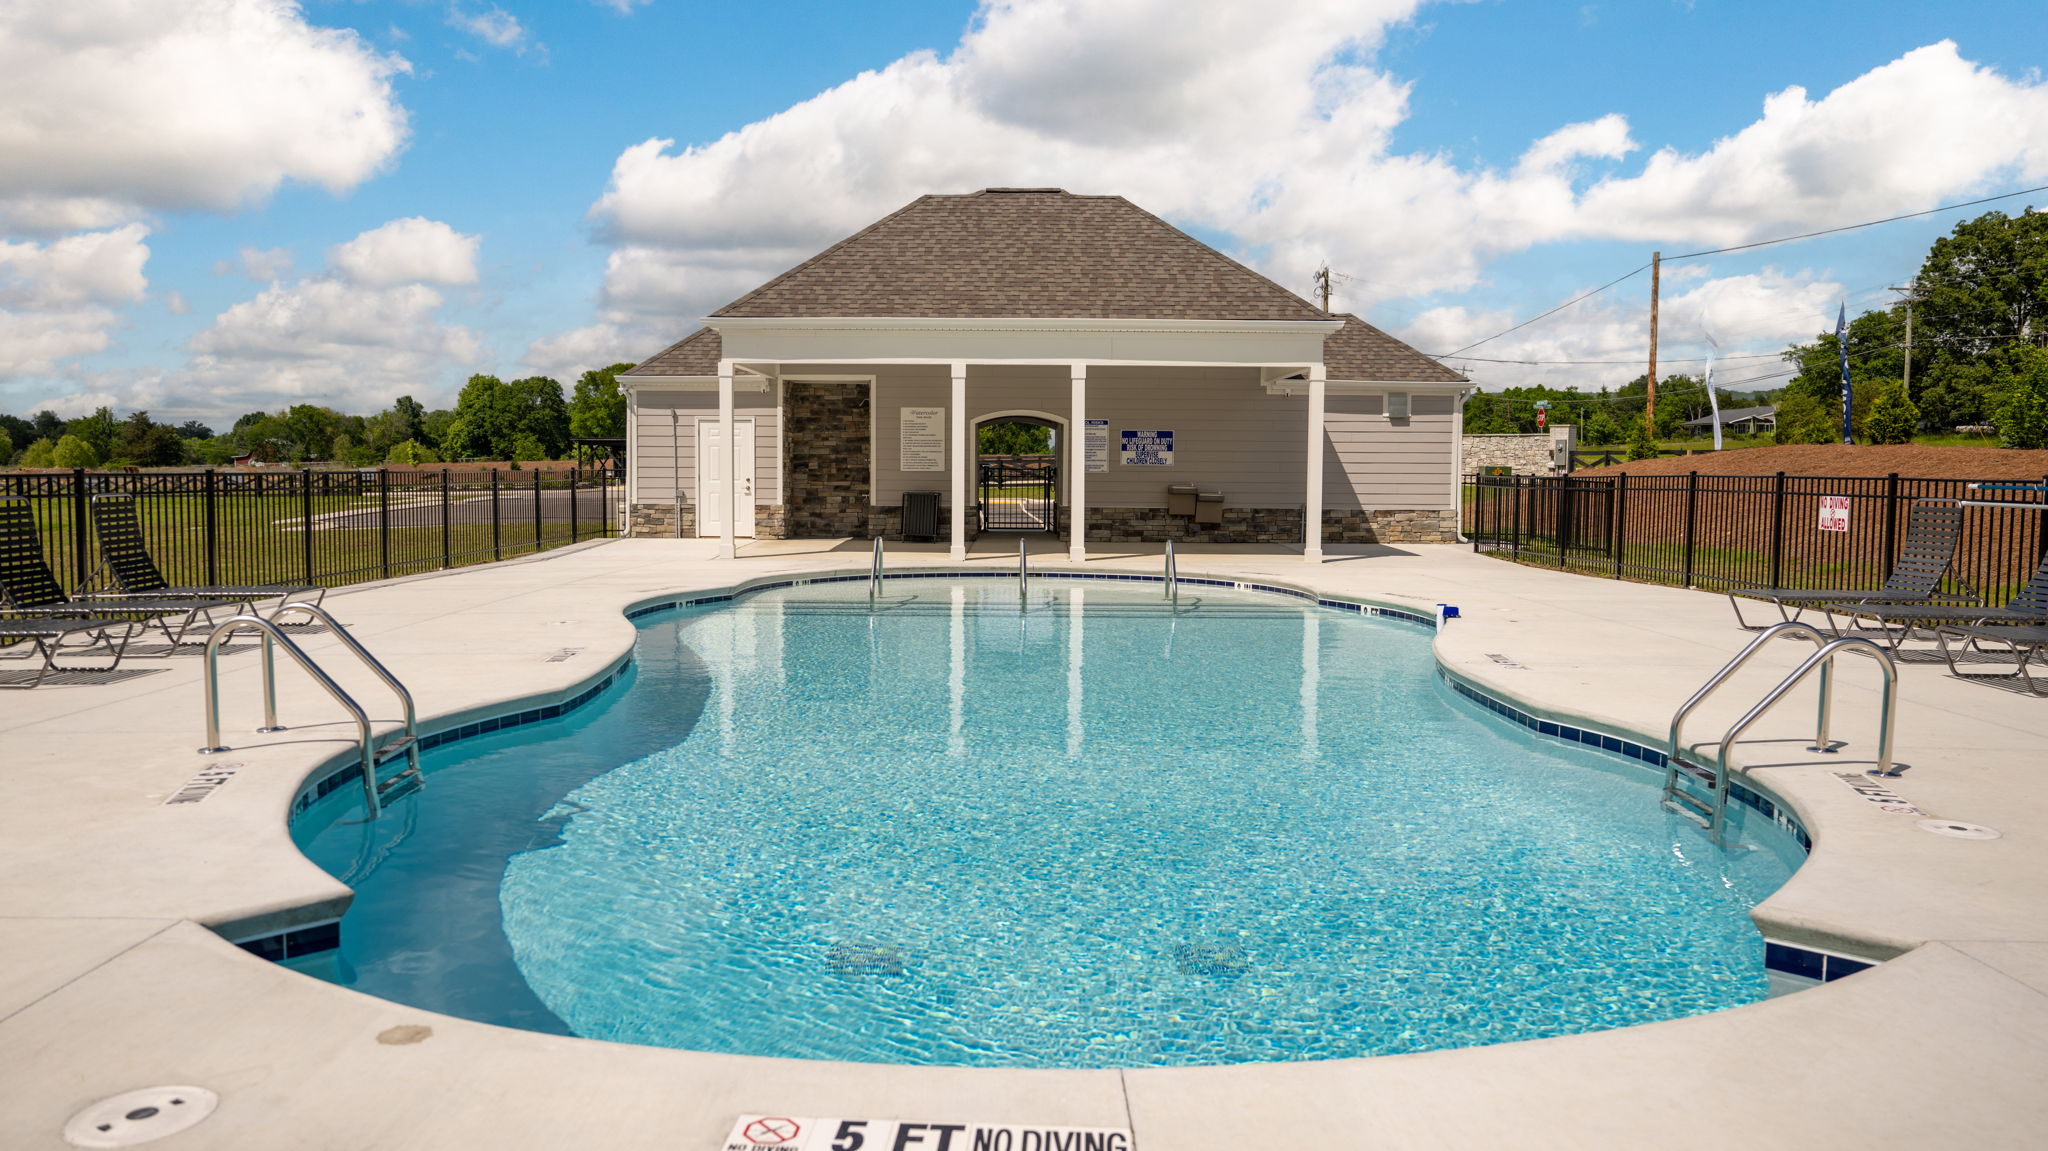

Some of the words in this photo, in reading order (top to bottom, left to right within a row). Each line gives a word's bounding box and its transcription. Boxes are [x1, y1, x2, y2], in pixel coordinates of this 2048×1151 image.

[1820, 496, 1827, 508] NO
[1829, 496, 1848, 509] DIVING
[1821, 517, 1845, 530] ALLOWED
[831, 1121, 867, 1151] 5
[892, 1124, 966, 1151] FT
[973, 1128, 1012, 1151] NO
[1021, 1130, 1128, 1151] DIVING
